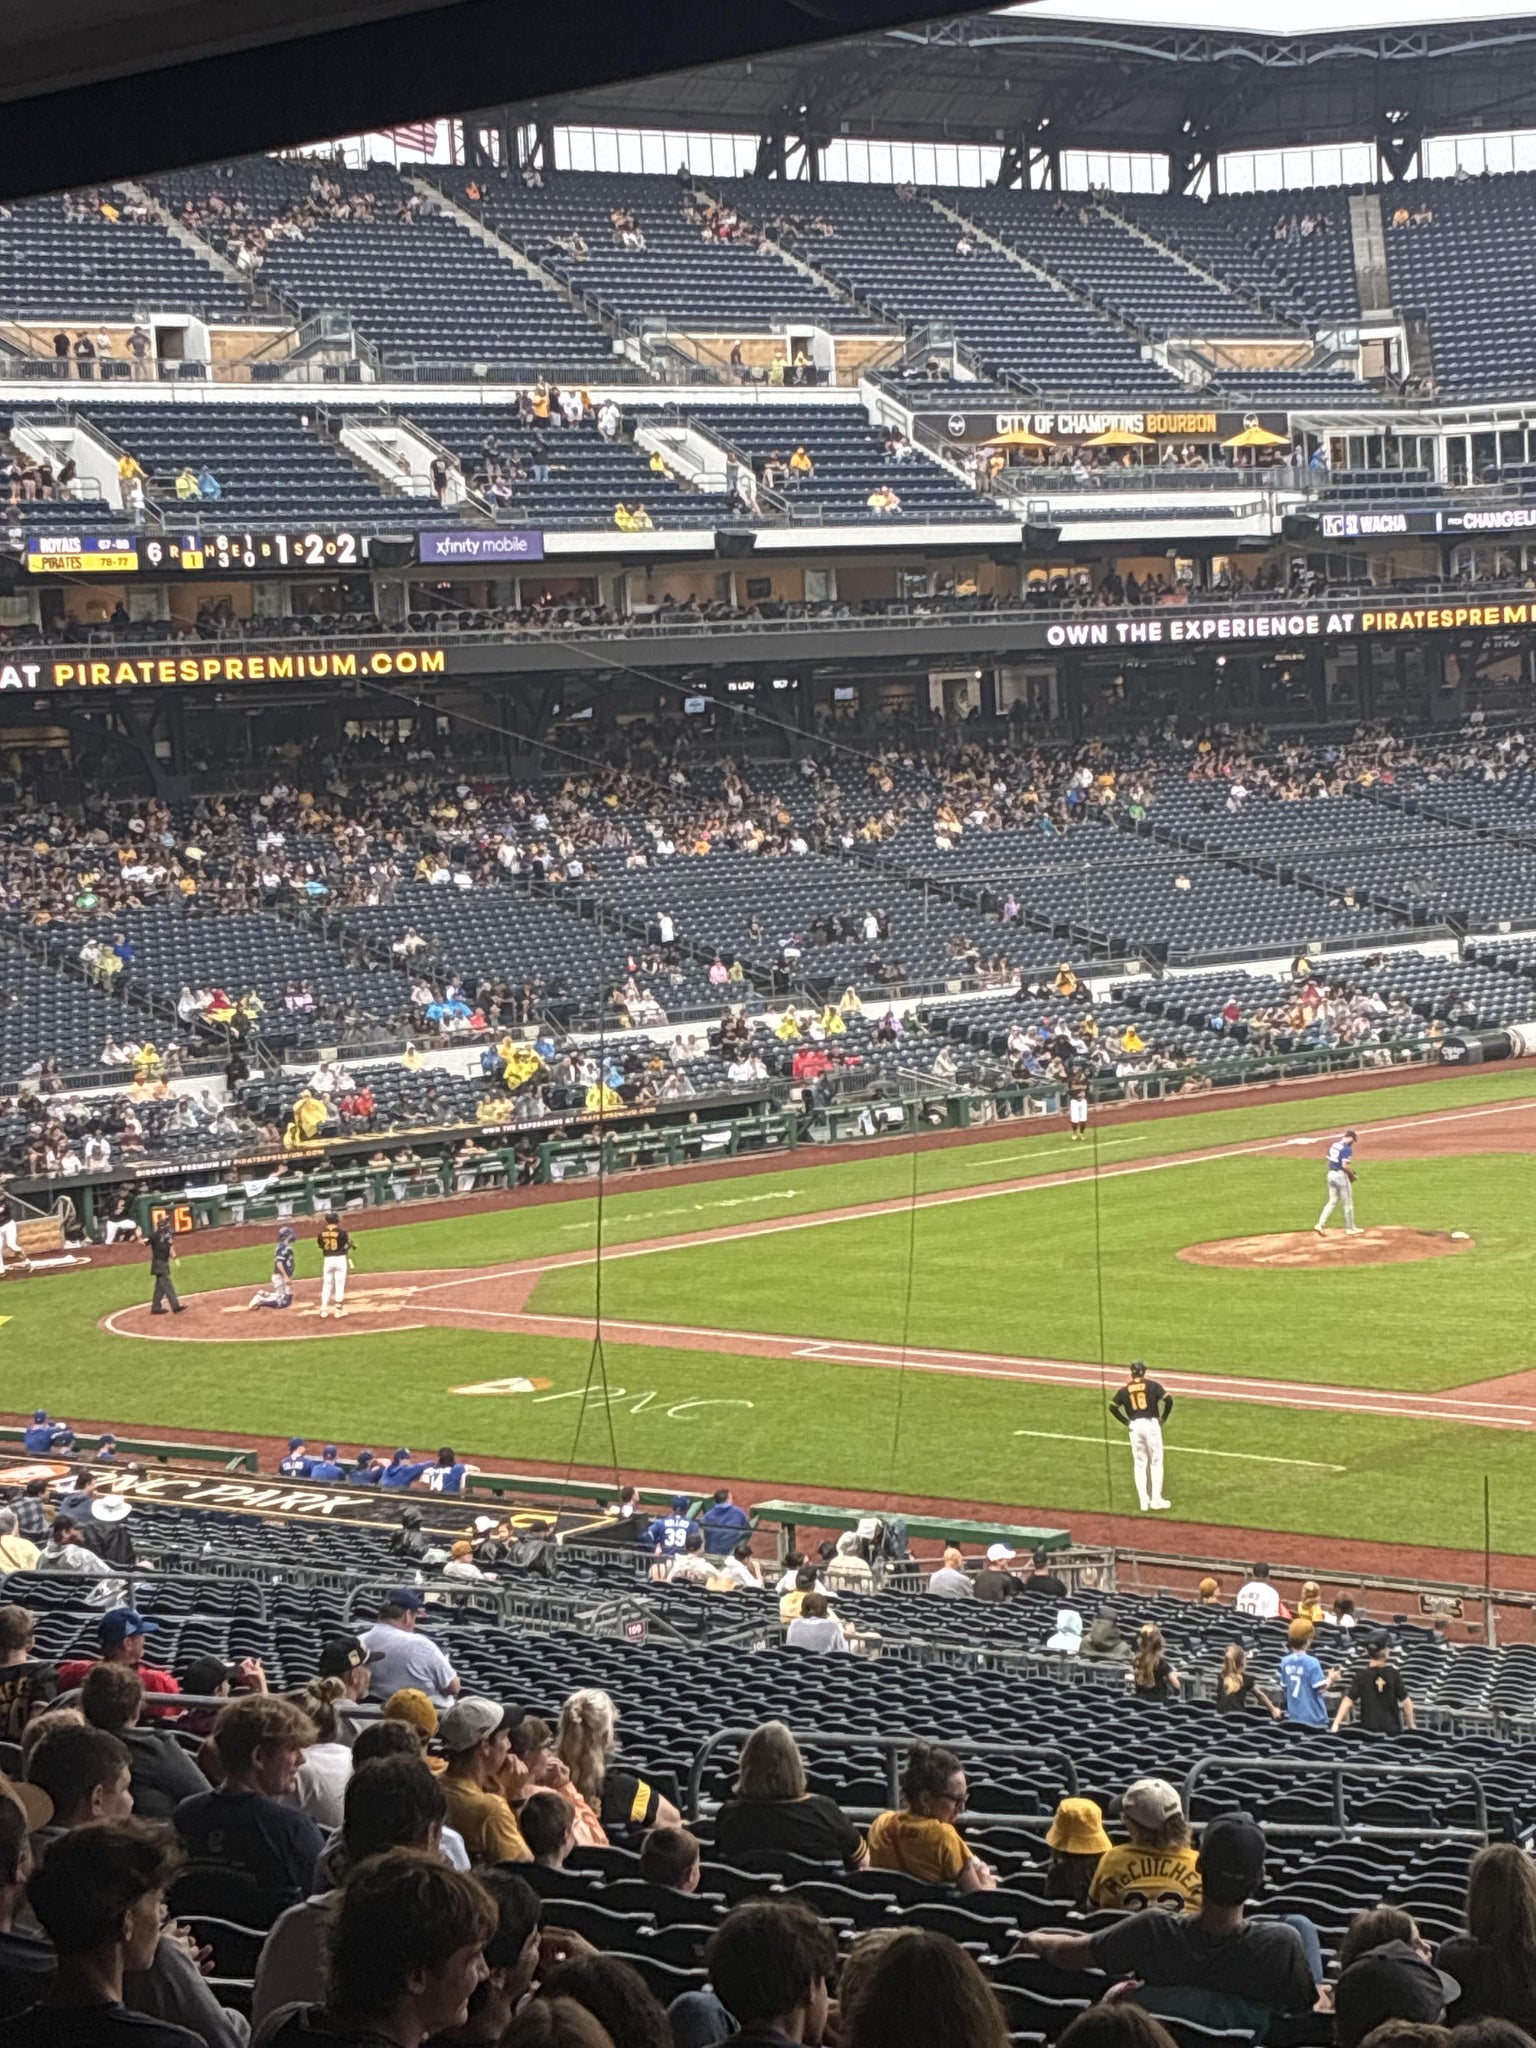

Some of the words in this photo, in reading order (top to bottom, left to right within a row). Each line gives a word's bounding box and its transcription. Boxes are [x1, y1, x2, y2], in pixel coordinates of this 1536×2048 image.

[997, 415, 1031, 433] CITY
[1034, 415, 1054, 433] OF
[1058, 414, 1143, 433] CHAMPIONS
[1147, 414, 1216, 432] BOURBON
[1360, 515, 1407, 533] WACHA
[40, 537, 81, 553] ROYALS
[276, 535, 288, 564] 1
[305, 534, 325, 564] 2
[337, 534, 357, 563] 2
[436, 537, 480, 556] xfinity
[482, 536, 528, 552] mobile
[42, 556, 82, 570] PIRATES
[218, 552, 229, 567] 3
[244, 552, 255, 567] 0
[1046, 624, 1107, 646] OWN
[1117, 622, 1162, 643] THE
[1170, 615, 1319, 641] EXPERIENCE
[1326, 614, 1354, 633] AT
[0, 665, 39, 689] AT
[54, 650, 445, 687] PIRATESPREMIUM.COM
[136, 1165, 179, 1177] DISCOVER
[181, 1161, 219, 1172] PREMIUM
[221, 1159, 232, 1168] AT
[182, 1482, 375, 1514] PARK
[664, 1528, 687, 1547] 39
[1290, 1674, 1301, 1698] 7
